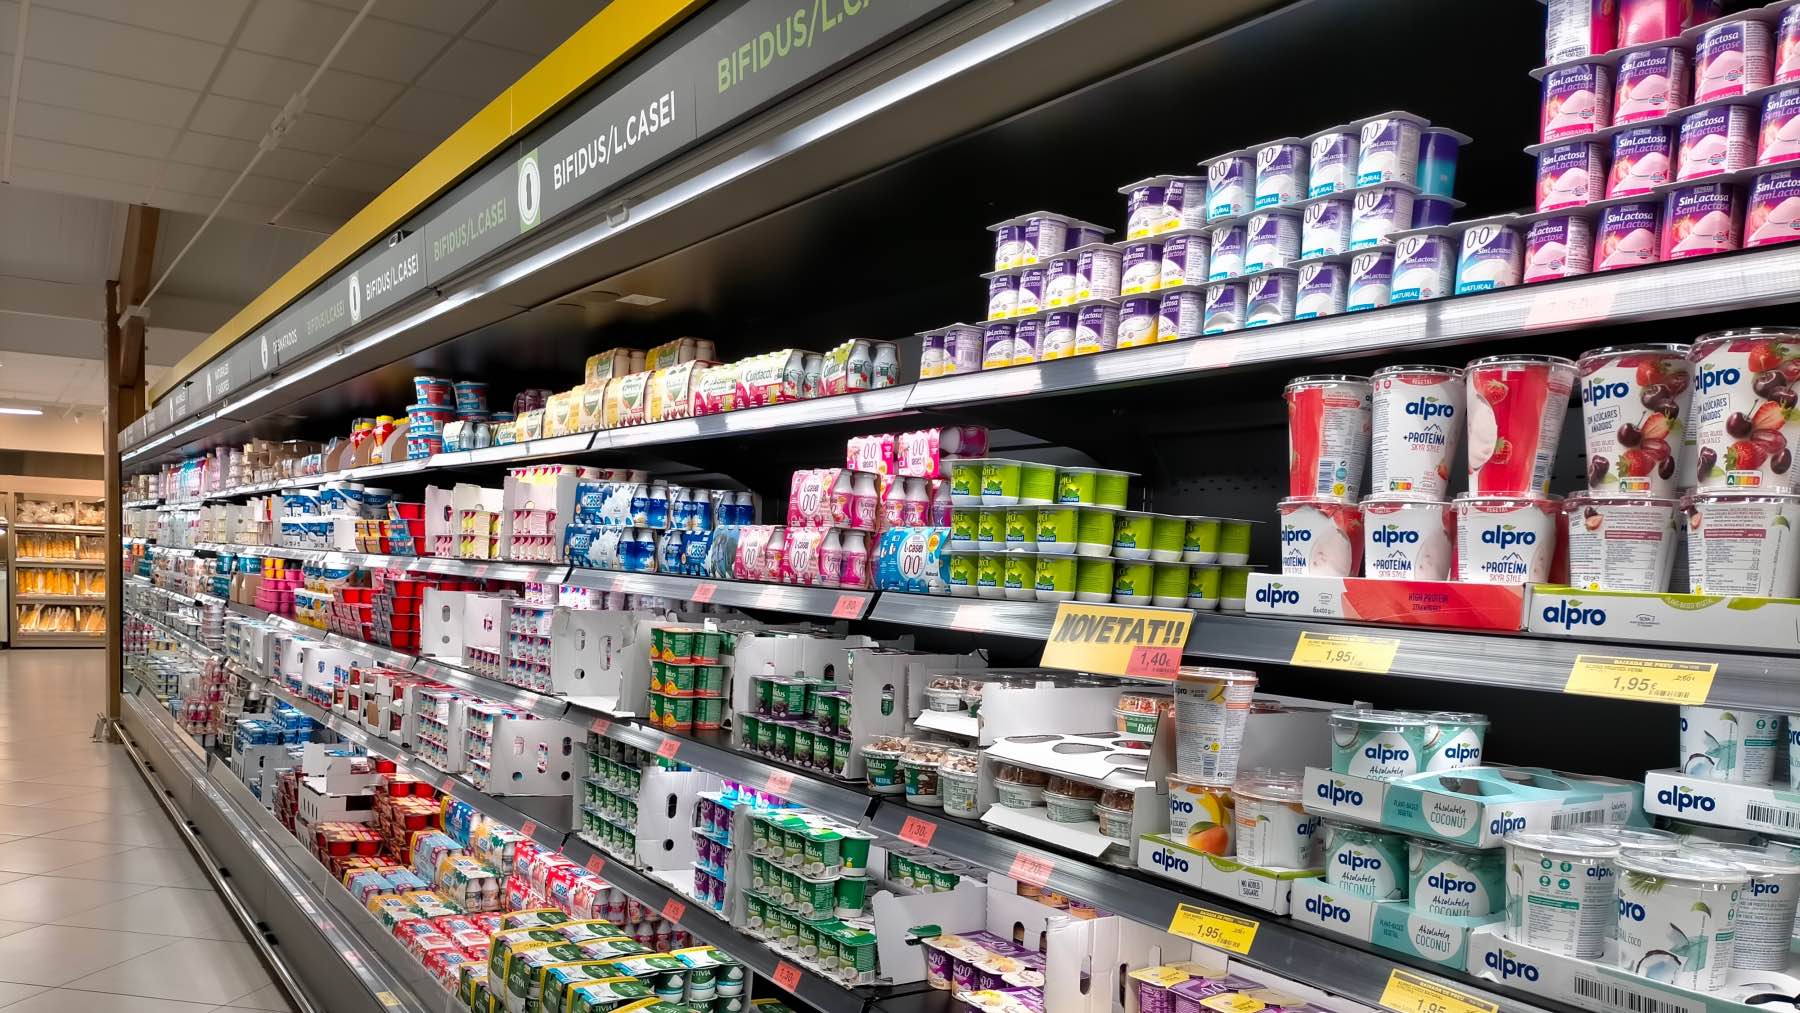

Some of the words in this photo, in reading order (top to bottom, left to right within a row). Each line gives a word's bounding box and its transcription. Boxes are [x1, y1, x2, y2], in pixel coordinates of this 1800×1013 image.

[717, 0, 870, 95] BIFIDUS/L.
[1620, 56, 1667, 72] SinLactosa
[1548, 72, 1593, 88] SinLactosa
[1766, 96, 1800, 111] SinLact
[1680, 115, 1724, 133] SinLactosa
[554, 90, 676, 191] BIFIDUS/L.CASEI
[1619, 134, 1667, 148] SinLactosa
[1542, 150, 1586, 166] SinLactosa
[1755, 178, 1800, 192] SinLactos
[1679, 193, 1729, 207] SinLactosa
[1607, 211, 1654, 224] SinLactosa
[433, 197, 508, 262] BIFIDUS/L.CASEI
[365, 252, 419, 302] BIFIDUS/L.CASEI
[1696, 366, 1740, 394] alpro
[1584, 380, 1629, 406] alpro
[1405, 399, 1454, 420] alpro
[1282, 525, 1312, 545] alpro
[1372, 525, 1419, 547] alpro
[1482, 525, 1536, 549] alpro
[1481, 560, 1527, 574] +PROTEÍNA
[1256, 583, 1299, 608] alpro
[1543, 600, 1606, 630] alpro
[1053, 613, 1185, 645] NOVETAT!!
[1365, 743, 1409, 764] alpro
[1445, 743, 1480, 763] alpro
[1317, 780, 1363, 806] alpro
[1657, 785, 1715, 812] alpro
[1170, 794, 1193, 814] lpro
[1434, 803, 1466, 815] Absolutely
[1297, 817, 1318, 839] alp
[1430, 812, 1467, 829] COCONUT
[1490, 812, 1526, 836] alpro
[1153, 848, 1188, 872] alpro
[1338, 850, 1382, 870] alpro
[1342, 871, 1376, 883] Absolutely
[1428, 872, 1476, 894] alpro
[1305, 895, 1351, 923] alpro
[1432, 895, 1470, 909] Absolutely
[1415, 933, 1451, 953] COCONUT
[1418, 925, 1450, 940] Absolutely
[1485, 948, 1539, 982] alpro
